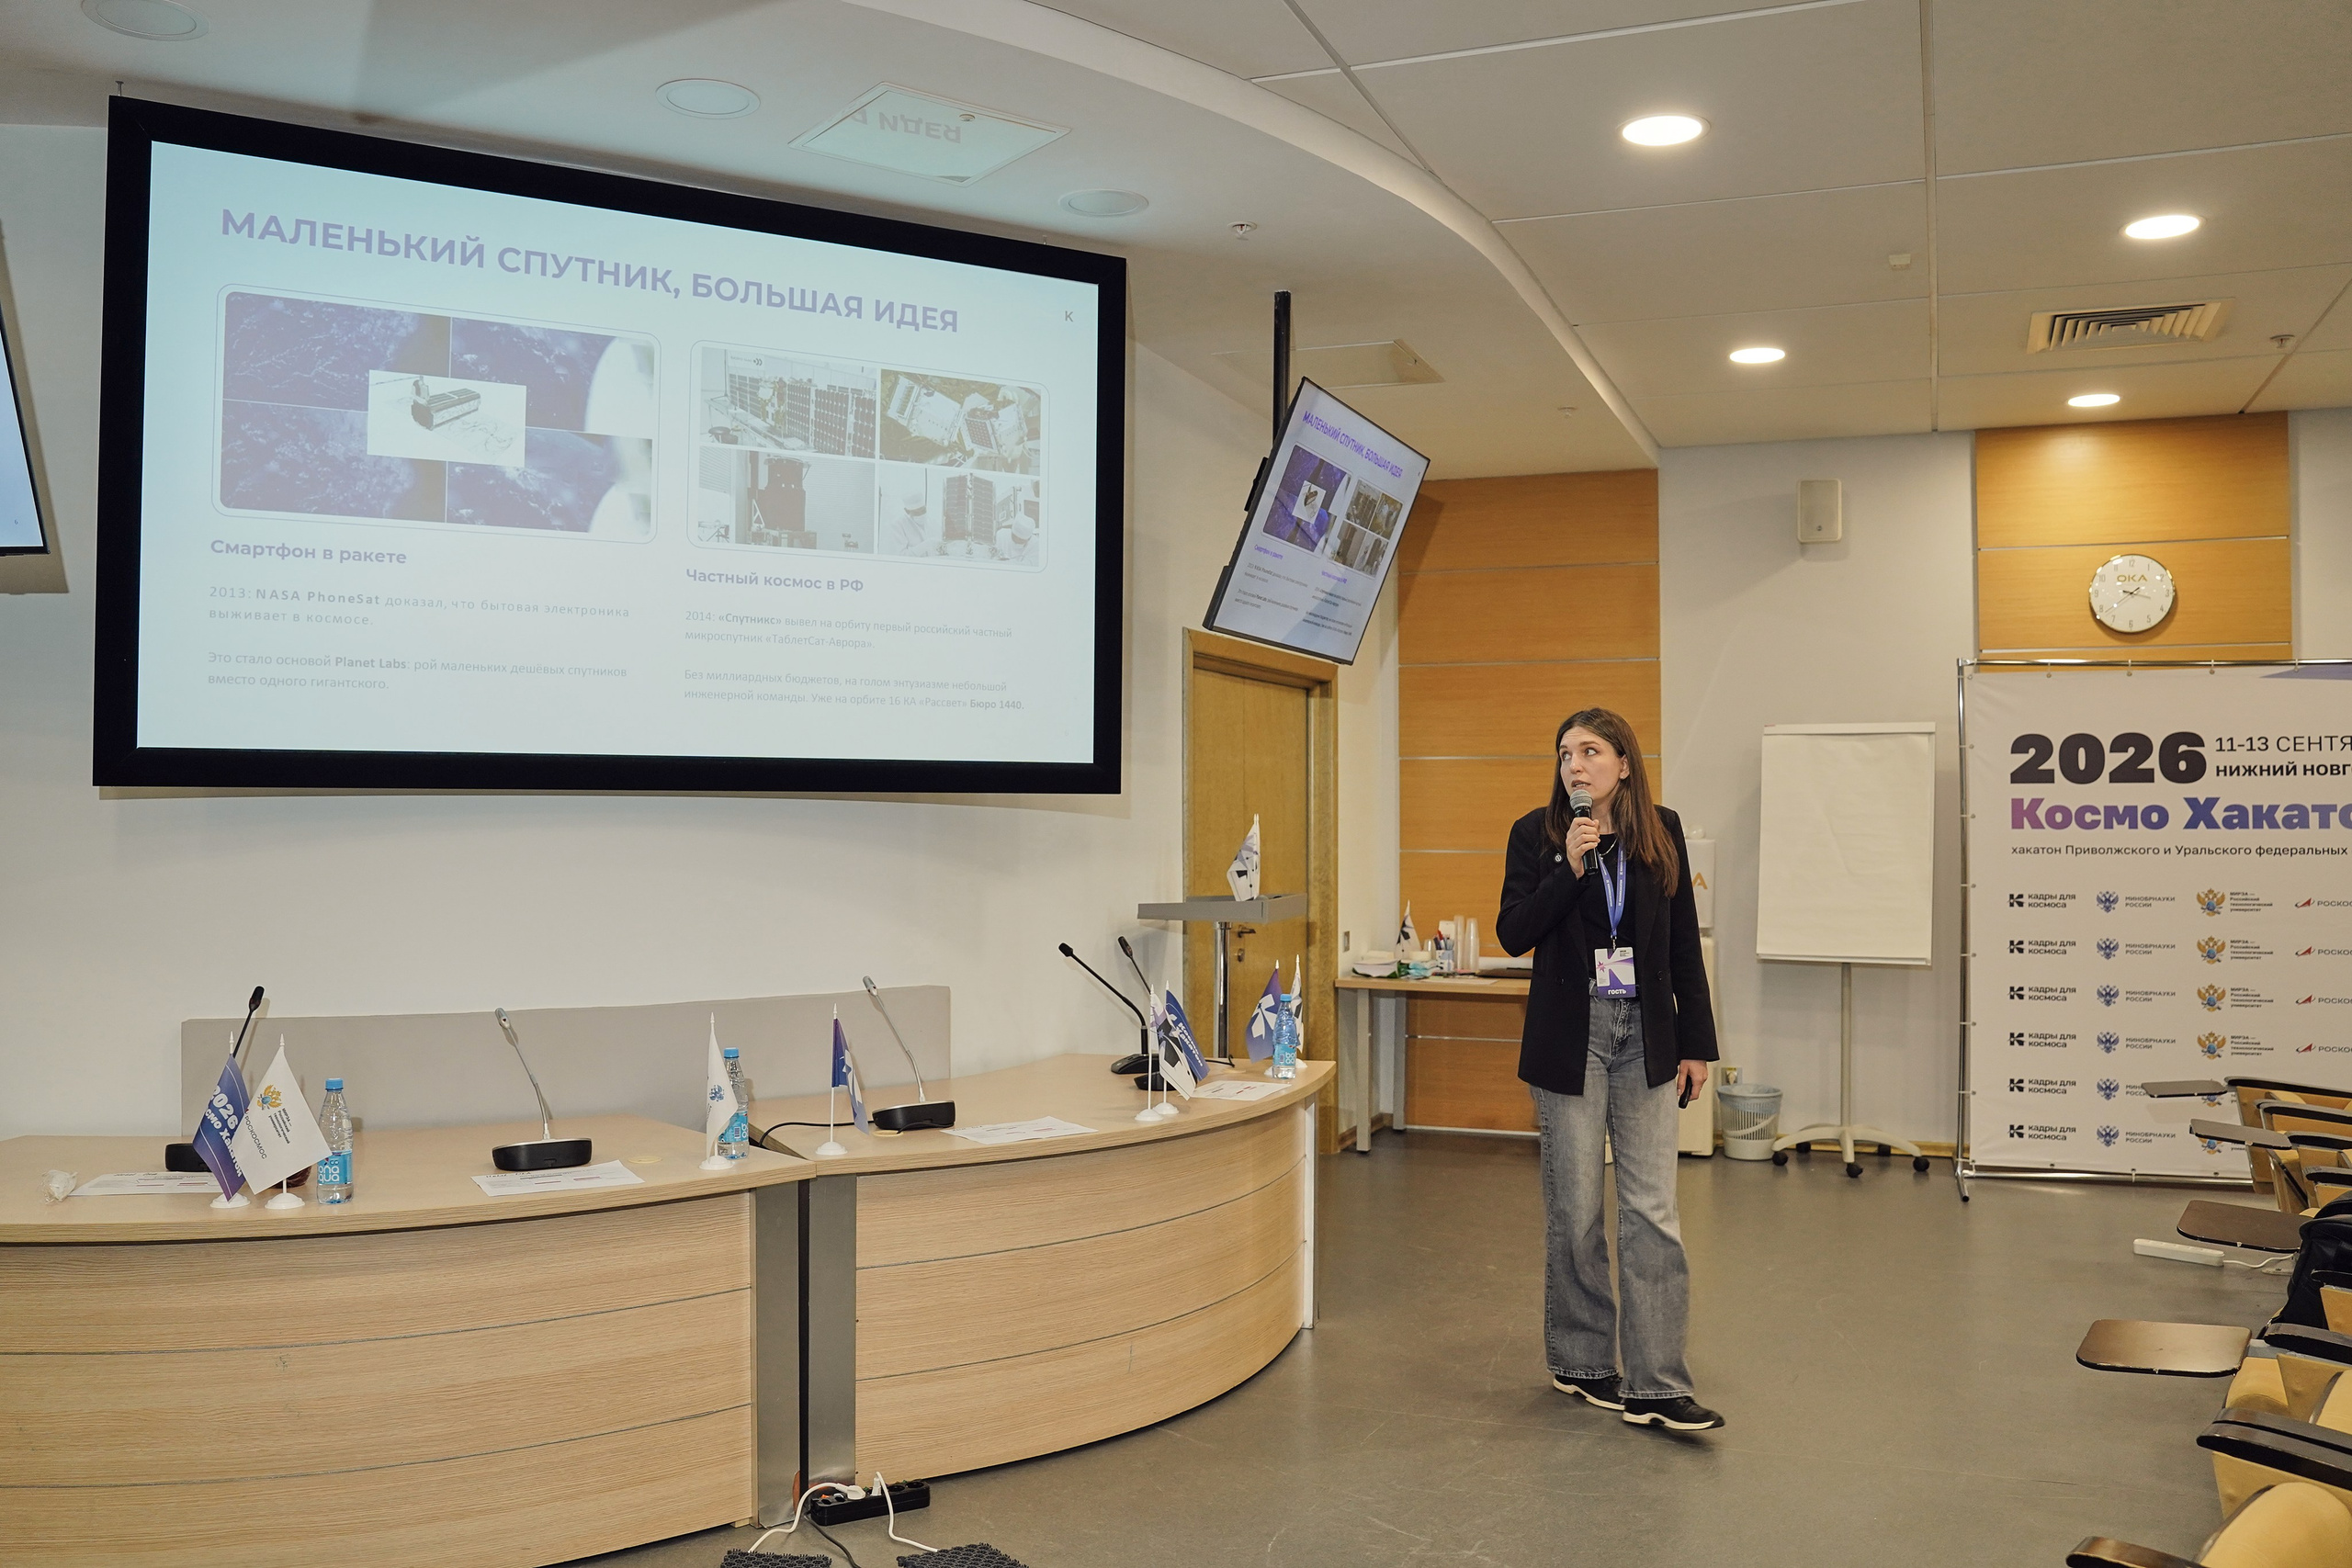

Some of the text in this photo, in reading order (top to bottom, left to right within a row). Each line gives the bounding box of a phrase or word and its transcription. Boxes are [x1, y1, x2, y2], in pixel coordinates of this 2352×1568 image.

[221, 209, 958, 333] МАЛЕНЬКИЙ СПУТНИК, БОЛЬШАЯ ИДЕЯ
[1302, 410, 1341, 442] МАЛЕНЬКИЙ
[210, 540, 407, 563] Смартфон в ракете
[2128, 559, 2135, 568] 12
[686, 569, 864, 592] Частный космос в РФ
[209, 586, 629, 617] 2013: NASA PhoneSat доказал, что бытовая электроника
[209, 610, 373, 626] выживает в космосе.
[685, 611, 1012, 637] 2014: «Спутникс» вывел на орбиту первый российский частный
[684, 631, 763, 643] микроспутник
[208, 651, 627, 678] Это стало основой Planet Labs: рой маленьких дешёвых спутников
[208, 674, 389, 689] вместо одного гигантского.
[684, 670, 1007, 692] Без миллиардных бюджетов, на голом энтузиазме небольшой
[684, 689, 753, 701] инженерной
[756, 693, 808, 704] команды.
[810, 694, 831, 704] Уже
[835, 695, 847, 704] на
[850, 695, 886, 706] орбите
[889, 696, 900, 705] 16
[903, 696, 916, 705] КА
[970, 700, 996, 711] Бюро
[999, 700, 1024, 710] 1440.
[2215, 736, 2269, 752] 11-13
[2009, 731, 2207, 784] 2026
[2011, 796, 2169, 830] Космо
[2011, 844, 2348, 857] хакатон Приволжского и Уральского федеральных
[2028, 1078, 2058, 1087] кадры
[244, 1115, 267, 1160] РОСКОСМОС
